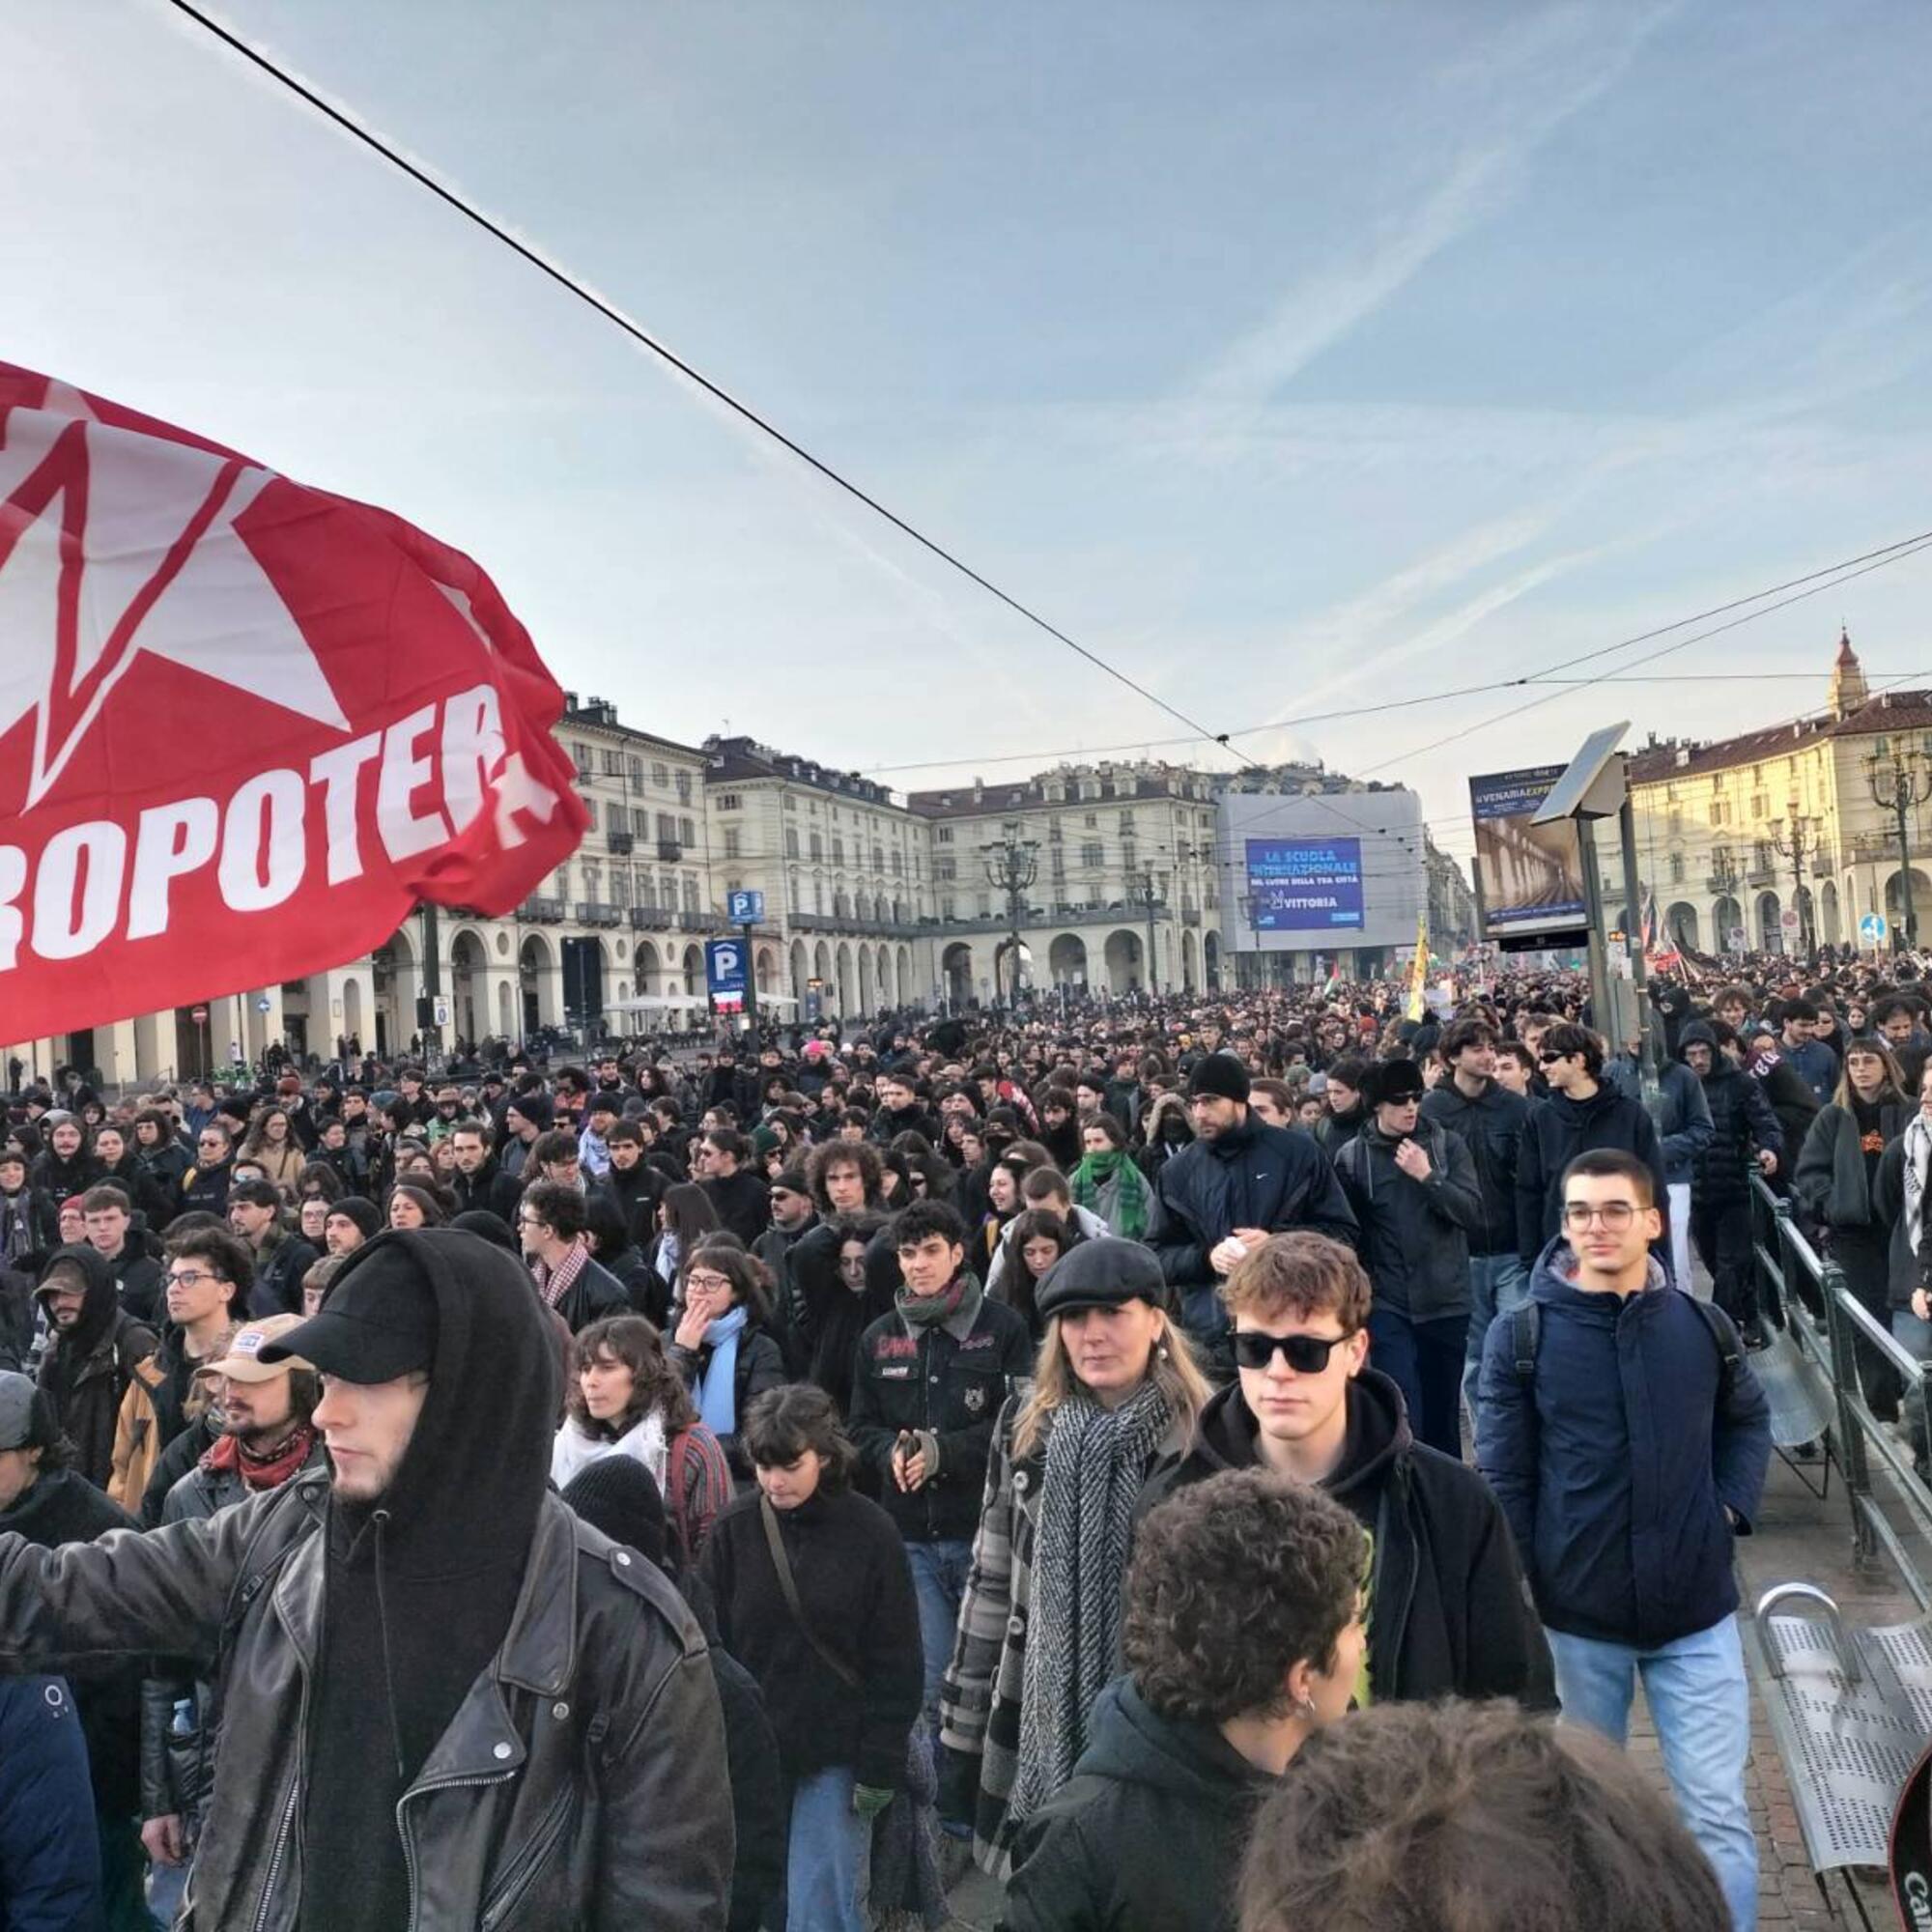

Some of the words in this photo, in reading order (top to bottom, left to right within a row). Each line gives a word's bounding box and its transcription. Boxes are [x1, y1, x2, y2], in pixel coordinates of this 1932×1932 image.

[1264, 851, 1280, 863] LA
[1285, 850, 1337, 862] SCUOLA
[734, 897, 748, 916] P
[1284, 896, 1338, 909] VITTORIA
[715, 951, 738, 980] P
